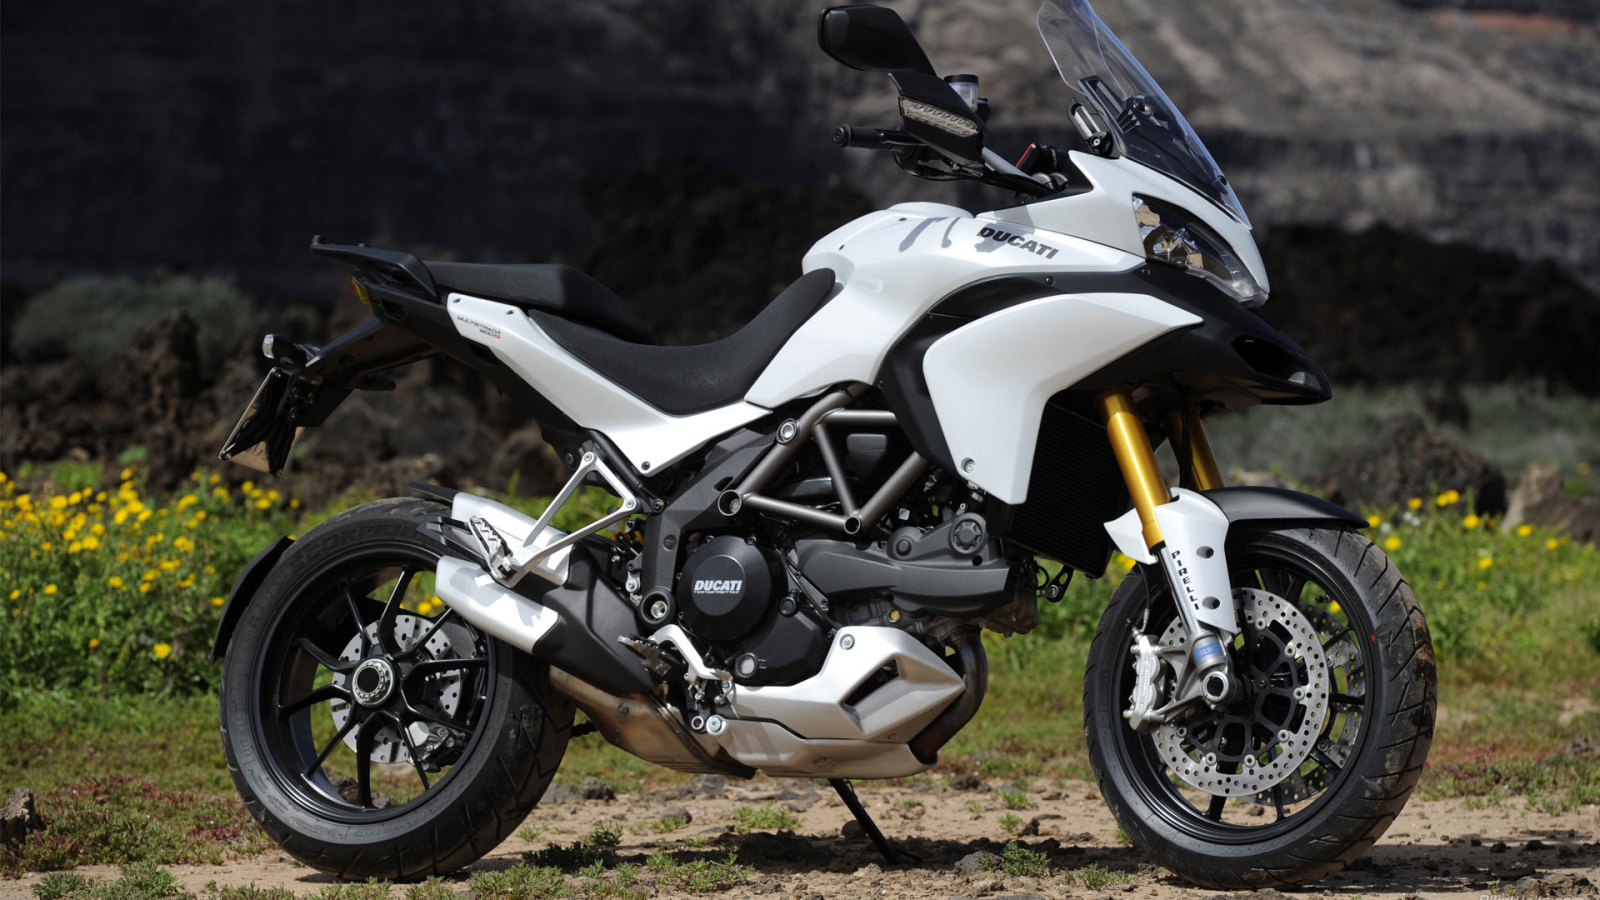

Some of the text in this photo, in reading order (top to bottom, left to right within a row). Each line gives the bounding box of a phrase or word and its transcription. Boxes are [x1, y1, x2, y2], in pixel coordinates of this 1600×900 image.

[976, 227, 1059, 259] DUCATI
[457, 316, 501, 333] MULTISTRADA
[693, 580, 743, 590] DUCATI
[1171, 550, 1199, 611] PIRELLI
